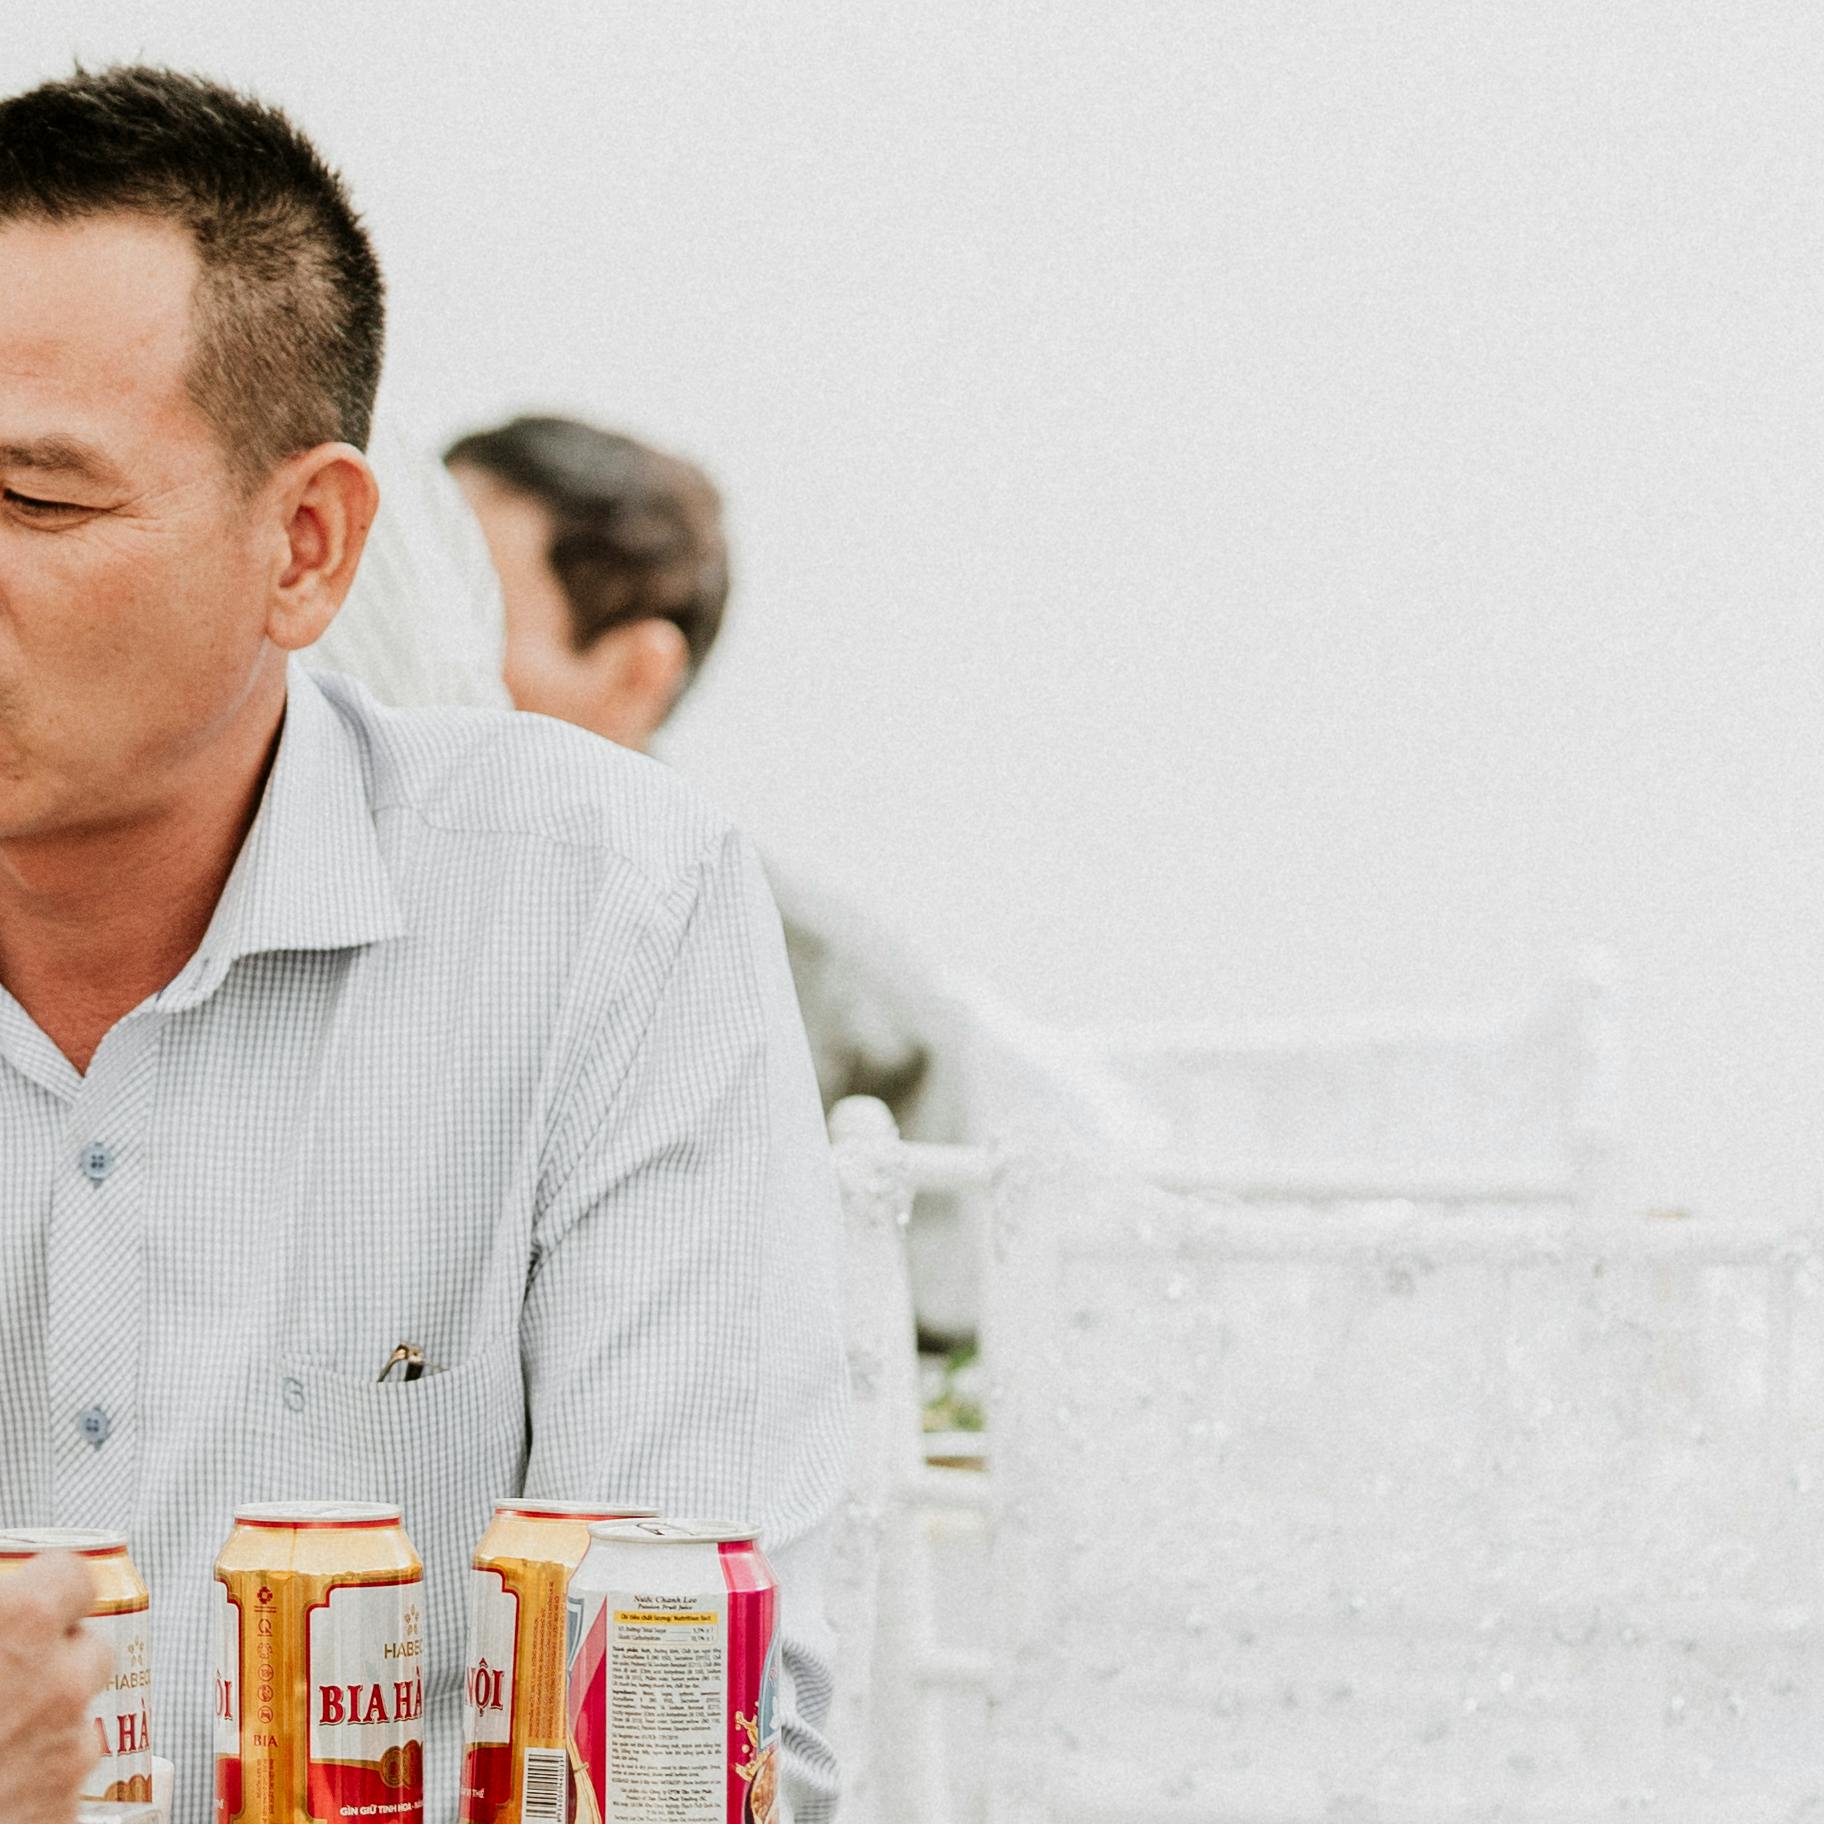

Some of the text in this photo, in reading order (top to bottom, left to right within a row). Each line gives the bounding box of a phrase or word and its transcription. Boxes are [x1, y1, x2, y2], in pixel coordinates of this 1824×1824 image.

[318, 1665, 424, 1726] BIA HÀ
[116, 1697, 151, 1755] HÀ
[253, 1734, 279, 1748] BIA
